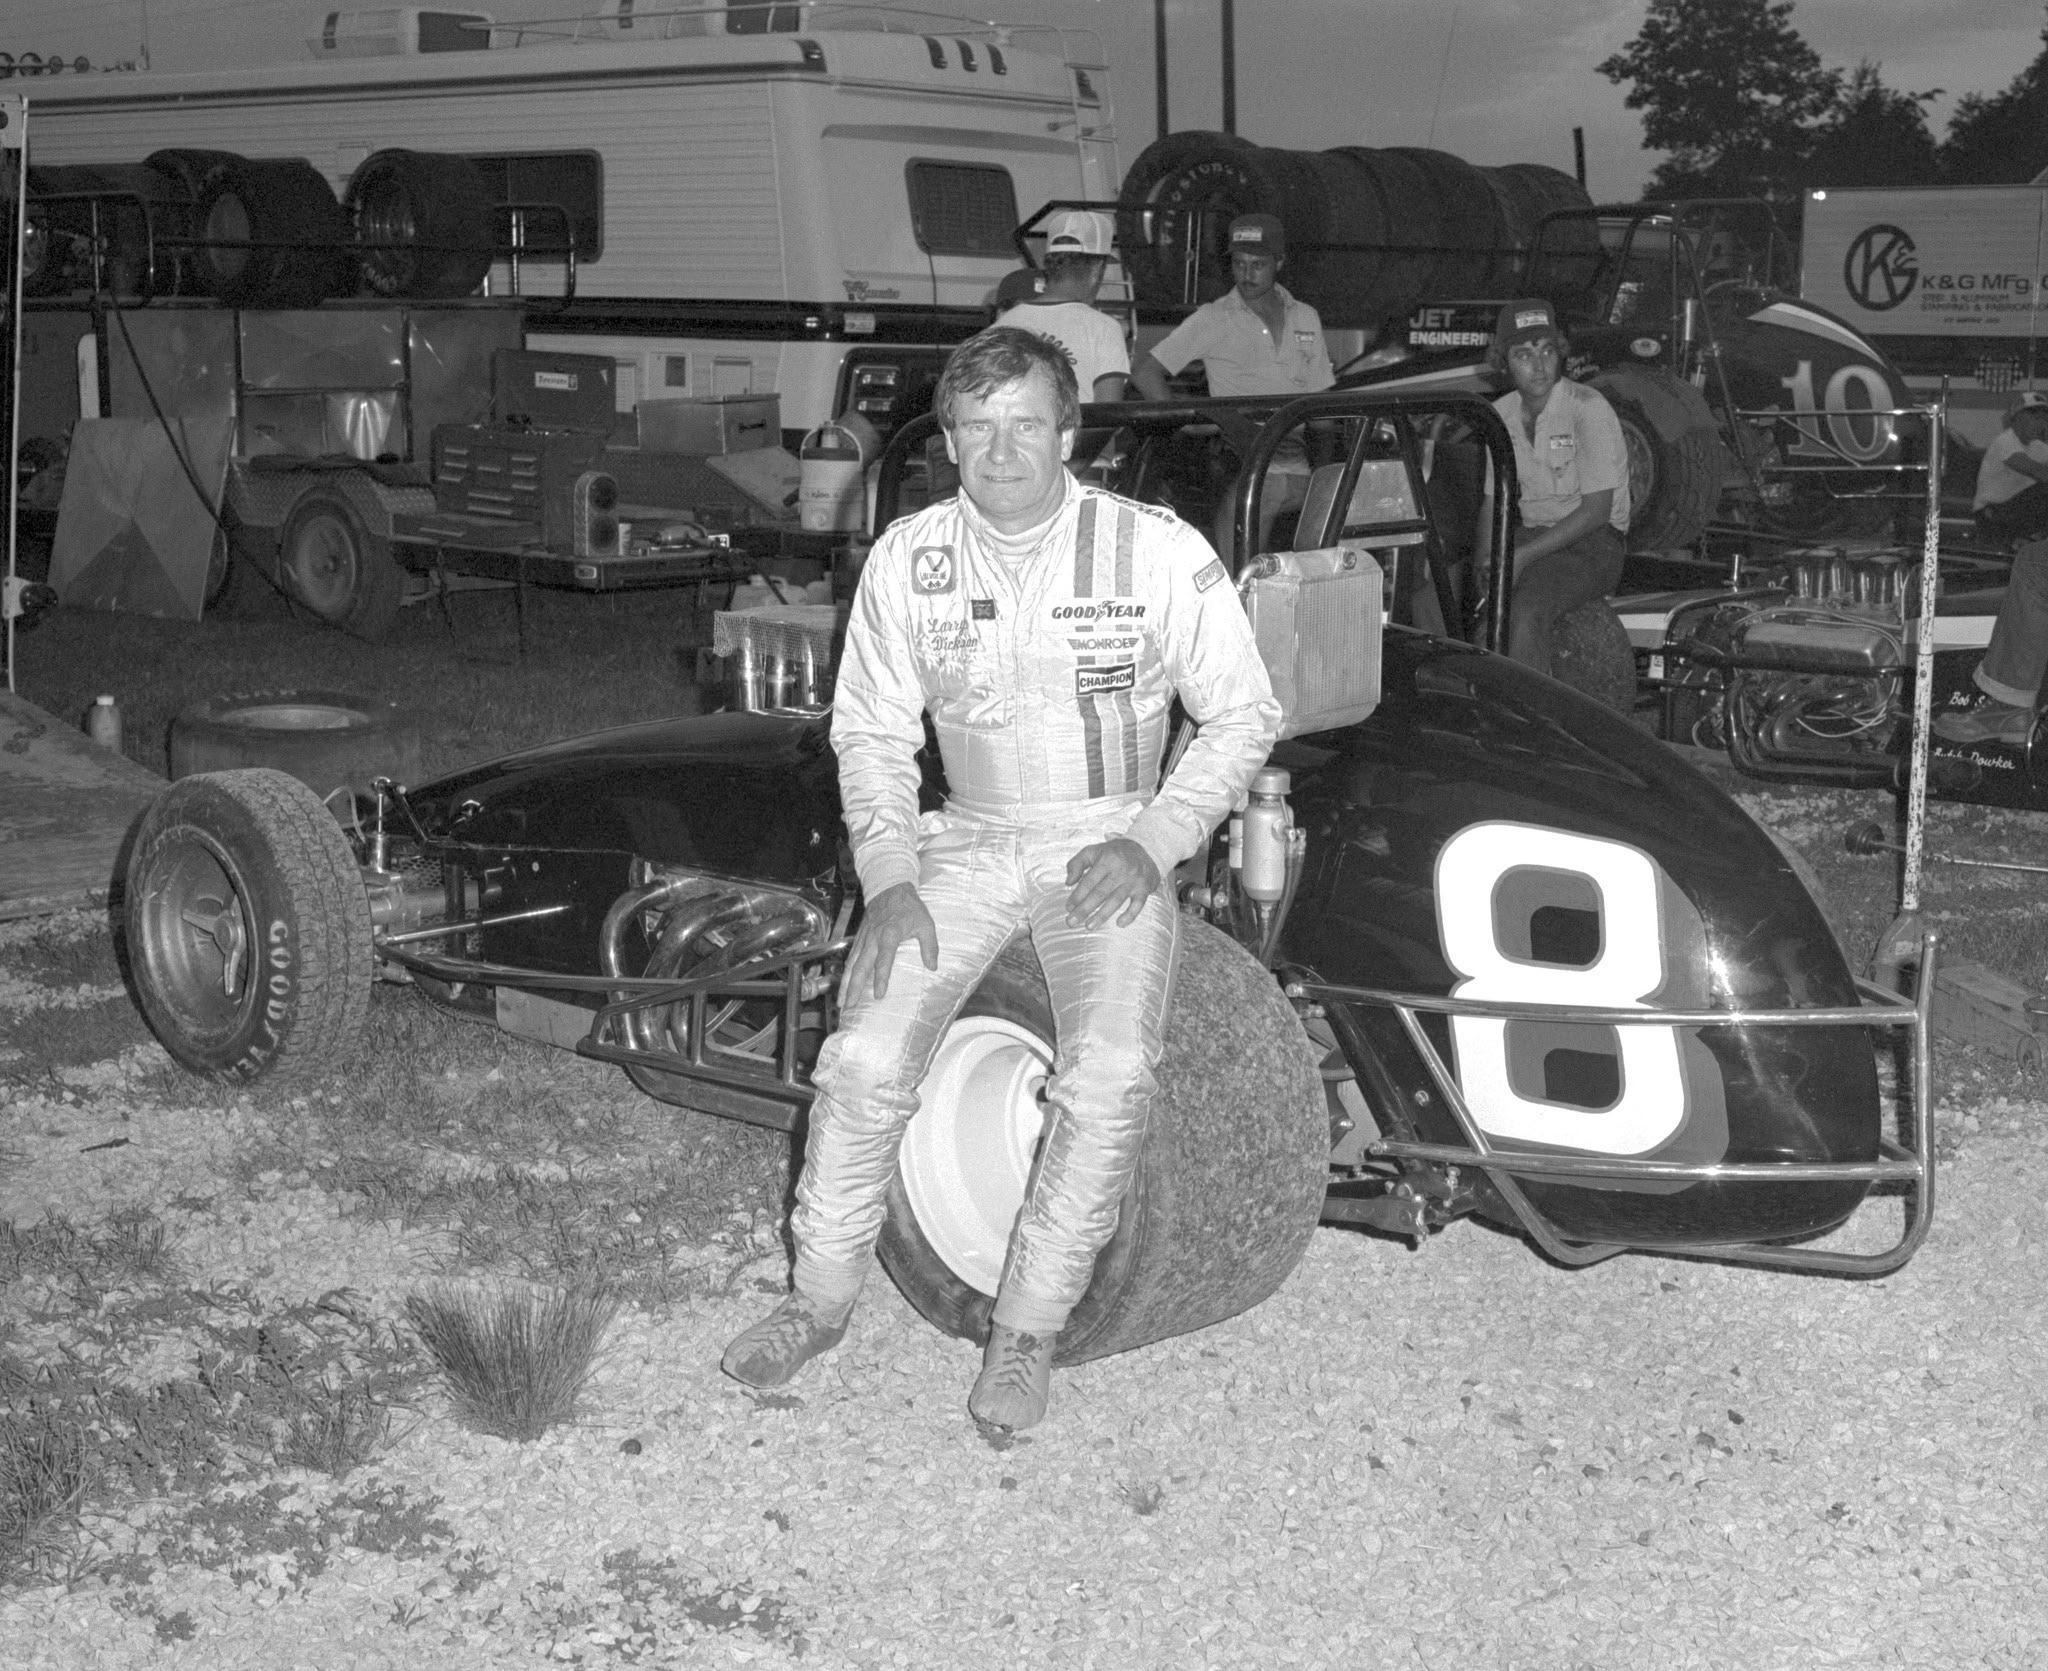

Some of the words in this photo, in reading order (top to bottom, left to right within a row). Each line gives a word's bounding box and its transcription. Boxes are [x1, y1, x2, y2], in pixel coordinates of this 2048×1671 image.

[1922, 274, 1975, 290] K&G
[1921, 303, 1970, 312] STAMPING
[1985, 303, 2048, 313] FABRICATO
[1409, 308, 1456, 329] JET
[1409, 331, 1495, 347] ENGINEERIN
[1781, 358, 1897, 462] 10
[927, 618, 969, 636] Larry
[931, 635, 978, 651] Dickson
[1076, 637, 1131, 650] MONROE
[1079, 671, 1132, 688] CHAMPION
[1949, 690, 1971, 706] Bob
[1434, 820, 1700, 1162] 8
